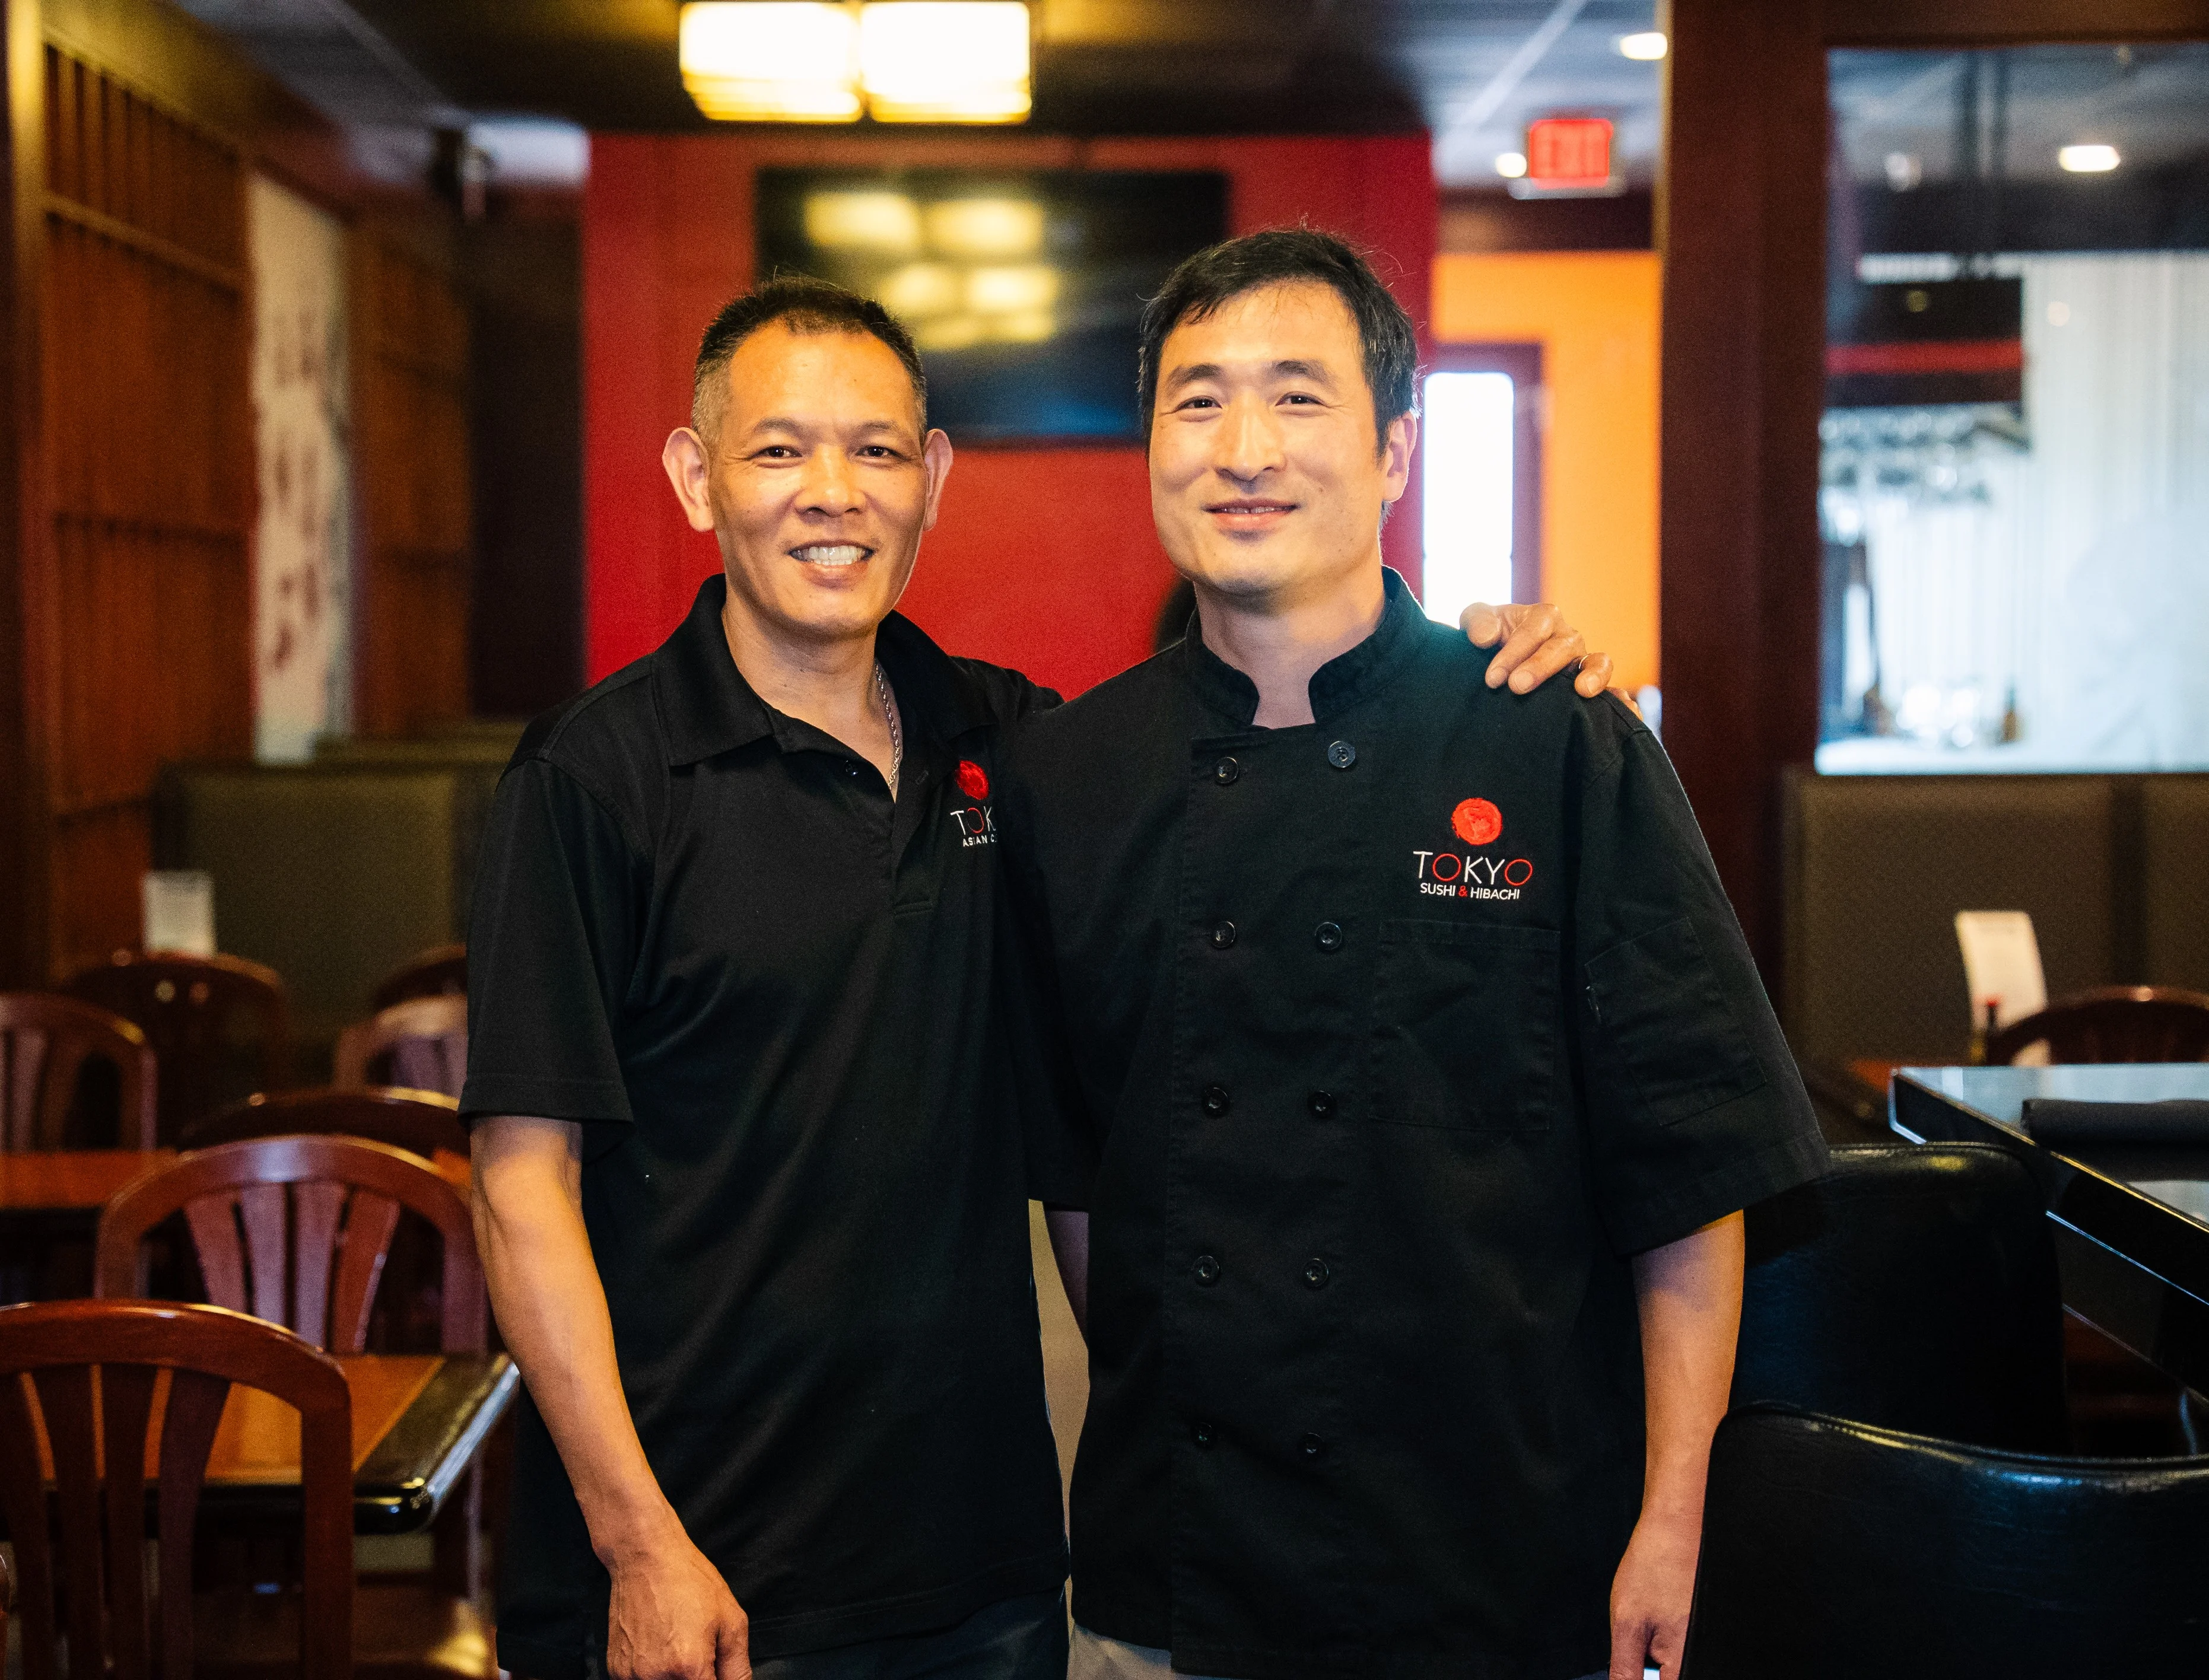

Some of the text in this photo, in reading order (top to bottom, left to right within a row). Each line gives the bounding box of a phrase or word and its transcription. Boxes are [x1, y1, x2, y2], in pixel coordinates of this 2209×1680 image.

[962, 835, 988, 847] ASIAN
[1413, 851, 1534, 886] TOKYO
[1420, 882, 1520, 901] SUSHI & HIBACHI
